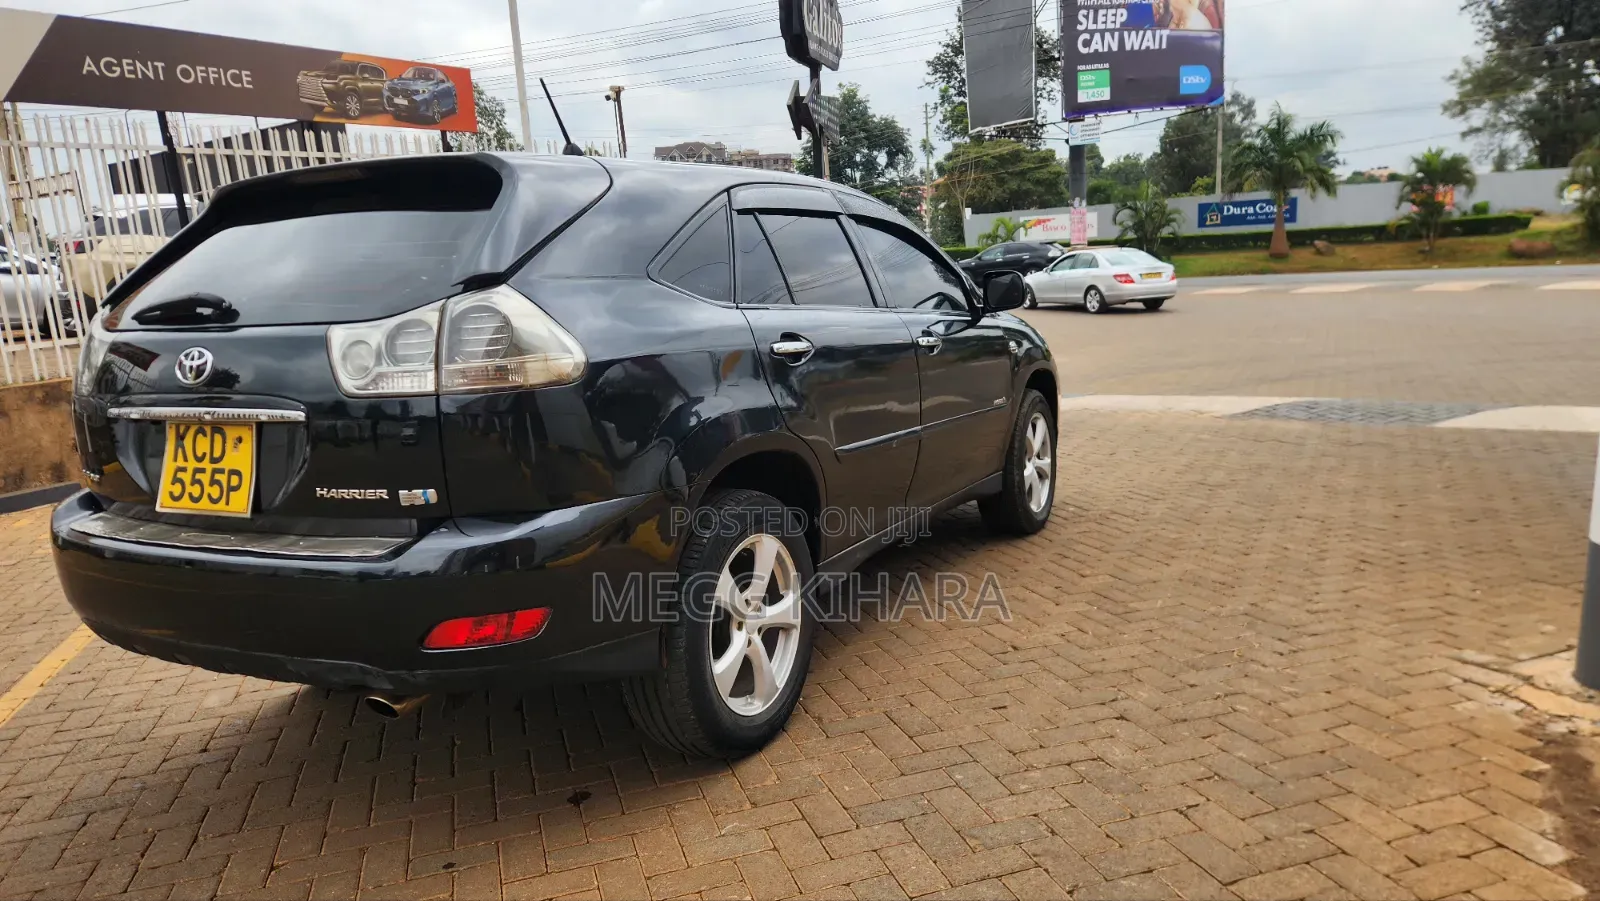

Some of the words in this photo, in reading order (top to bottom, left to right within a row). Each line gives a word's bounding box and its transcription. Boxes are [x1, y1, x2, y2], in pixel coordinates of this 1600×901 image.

[1076, 8, 1128, 31] SLEEP
[1077, 32, 1119, 54] CAN
[1123, 29, 1170, 51] WAIT
[82, 55, 166, 81] AGENT
[176, 64, 254, 89] OFFICE
[1086, 90, 1105, 100] 1,450
[1222, 204, 1254, 216] Dura
[1255, 202, 1281, 214] Coa
[172, 425, 227, 465] KCD
[168, 466, 243, 506] 555P
[315, 487, 390, 500] HARRIER
